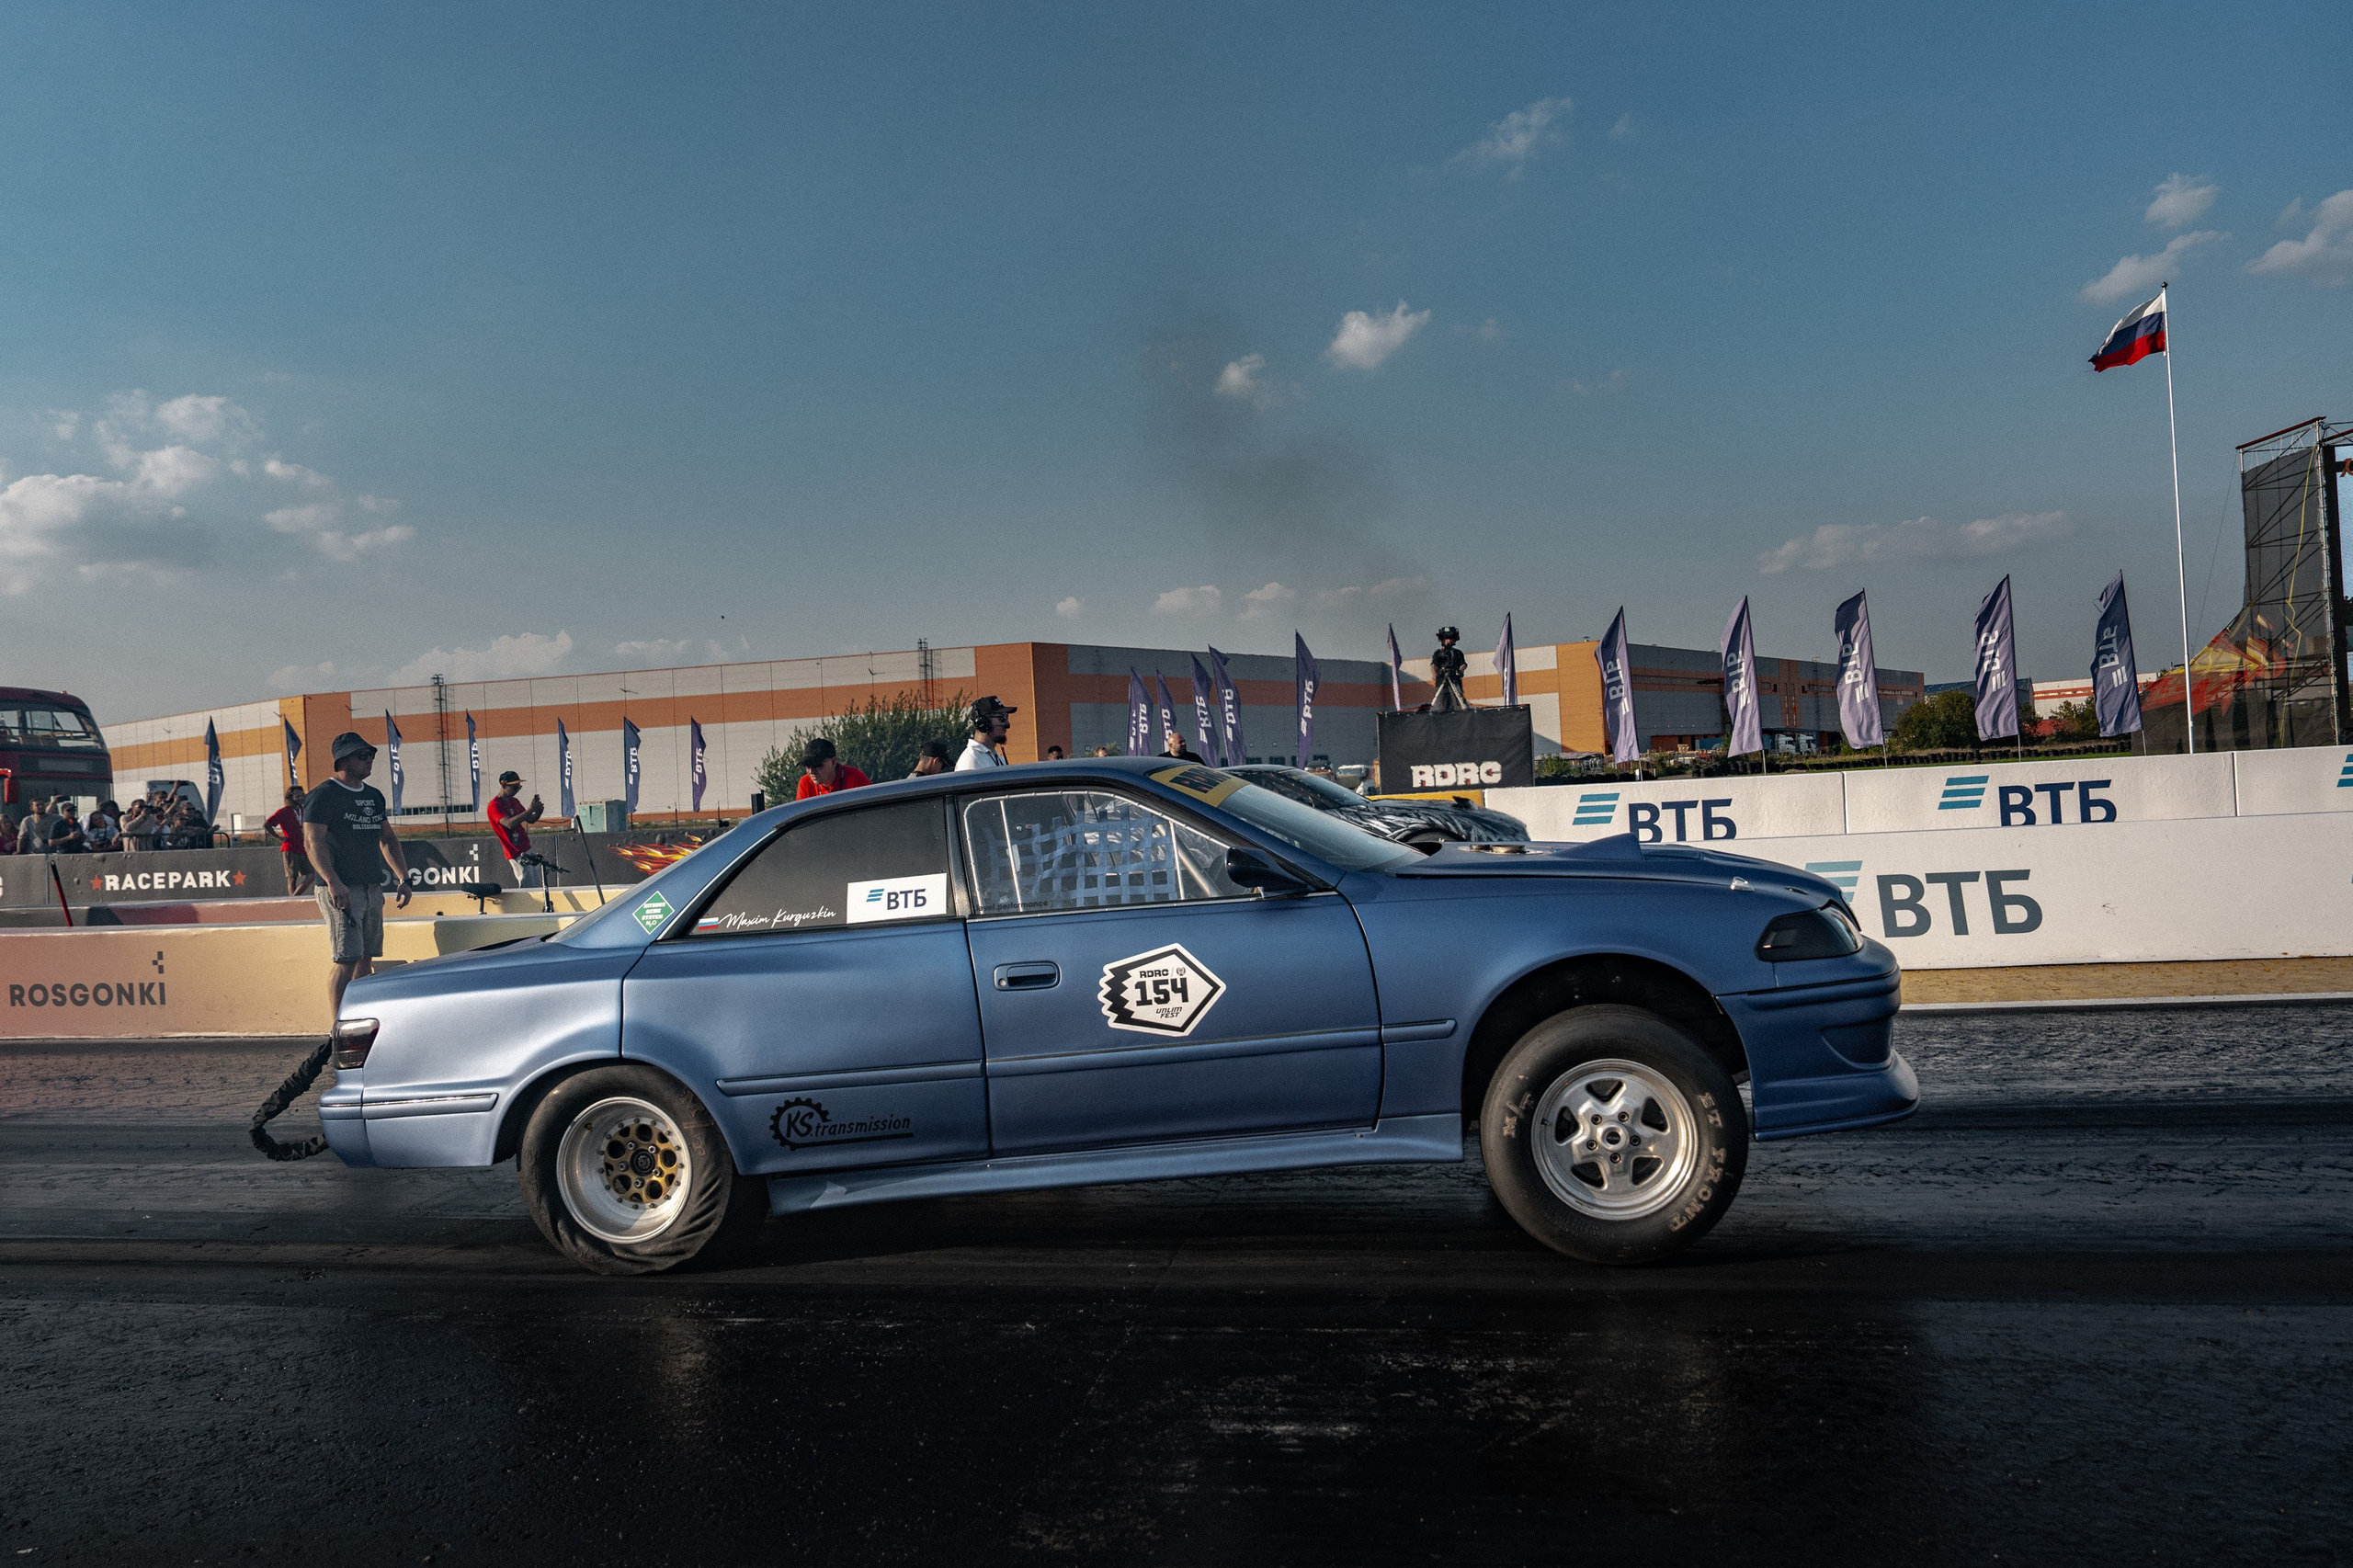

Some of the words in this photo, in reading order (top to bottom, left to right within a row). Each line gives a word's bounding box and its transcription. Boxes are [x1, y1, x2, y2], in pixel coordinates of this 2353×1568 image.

[1410, 760, 1502, 788] RDRC
[1998, 779, 2118, 827] ВТБ
[1628, 798, 1737, 844] ВТБ
[104, 869, 232, 892] RACEPARK
[887, 888, 927, 910] ВТБ
[1876, 869, 2043, 938] ВТБ
[719, 911, 770, 930] Maxim
[771, 905, 836, 928] Kurguzkin
[1140, 969, 1169, 978] RDRC
[9, 982, 166, 1007] ROSGONKI
[1134, 978, 1189, 1006] 154
[1670, 1147, 1727, 1233] FRONT
